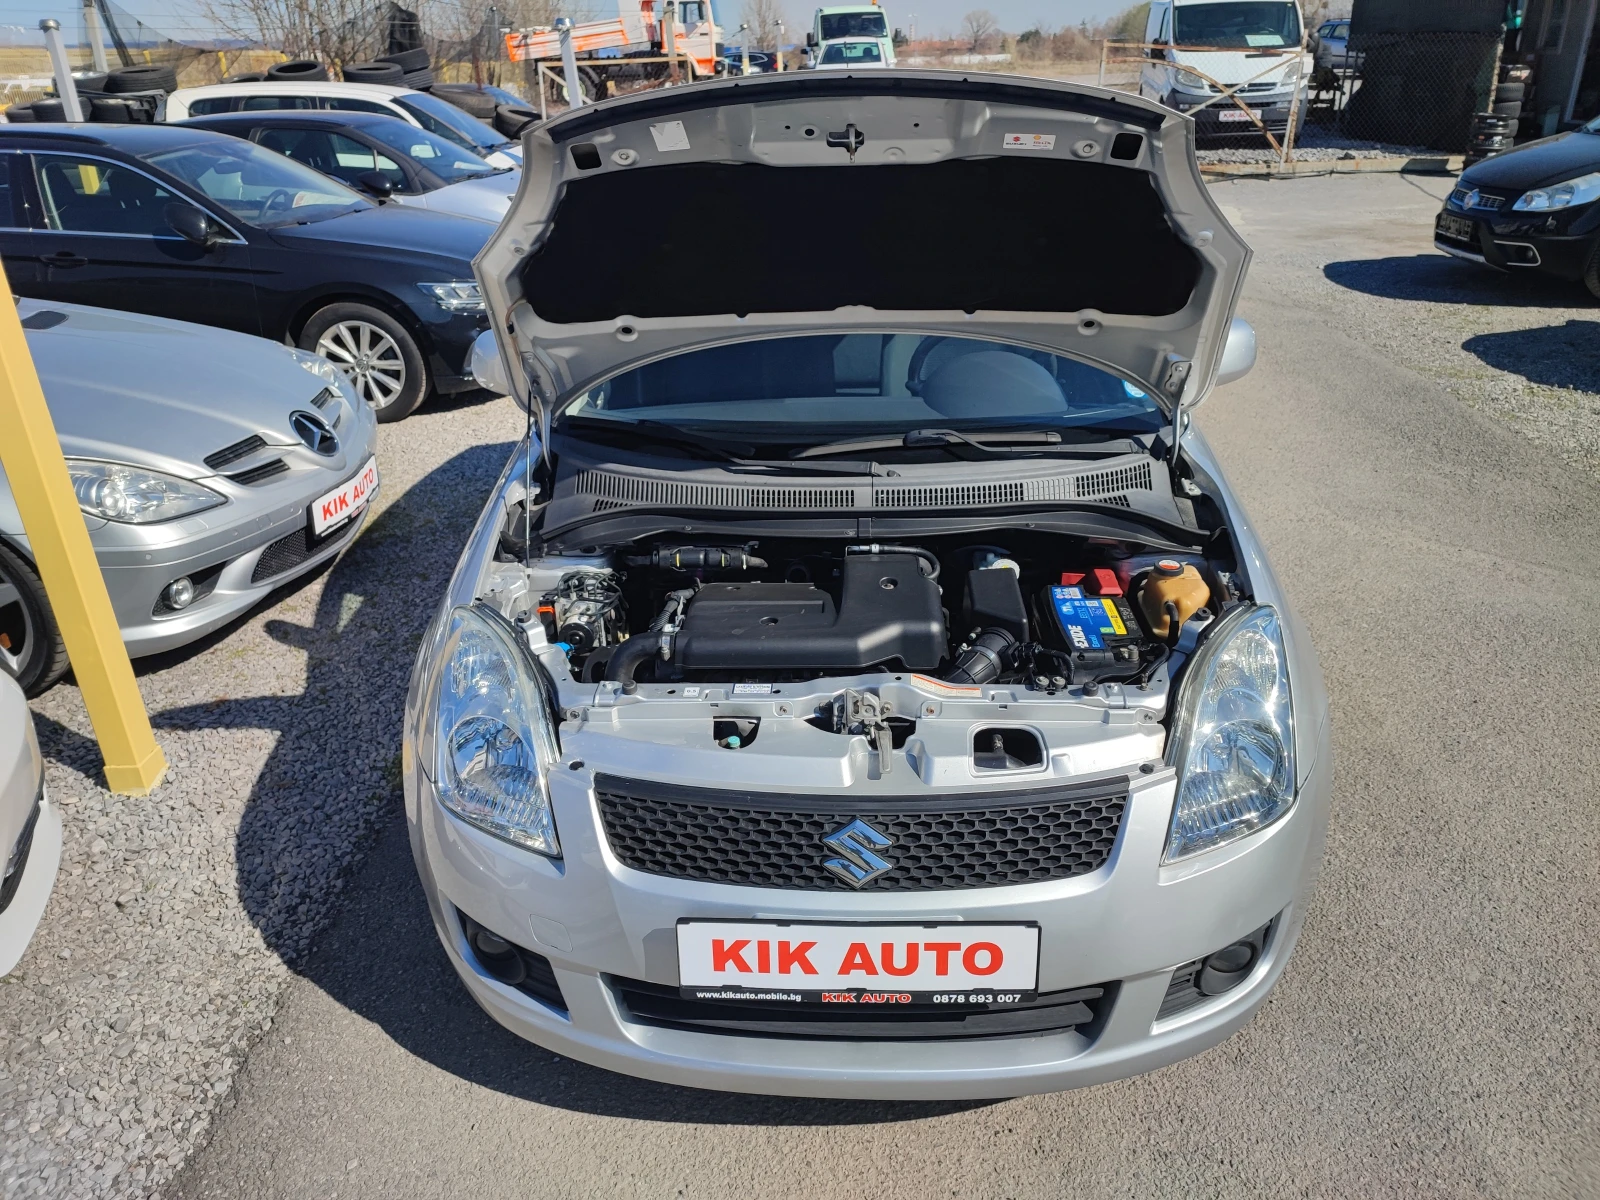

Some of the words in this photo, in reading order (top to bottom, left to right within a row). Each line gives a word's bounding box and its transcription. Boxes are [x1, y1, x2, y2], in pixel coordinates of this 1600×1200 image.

[322, 491, 349, 521] KIK
[352, 468, 373, 502] AUTO
[1067, 624, 1089, 649] EXIDE
[711, 938, 818, 976] KIK
[837, 941, 1004, 977] AUTO
[696, 990, 803, 1003] www.kikauto.mobile.bg
[821, 992, 857, 1004] KIK
[859, 992, 912, 1004] AUTO
[933, 994, 966, 1004] 0878
[968, 994, 996, 1003] 693
[997, 993, 1022, 1003] 007
